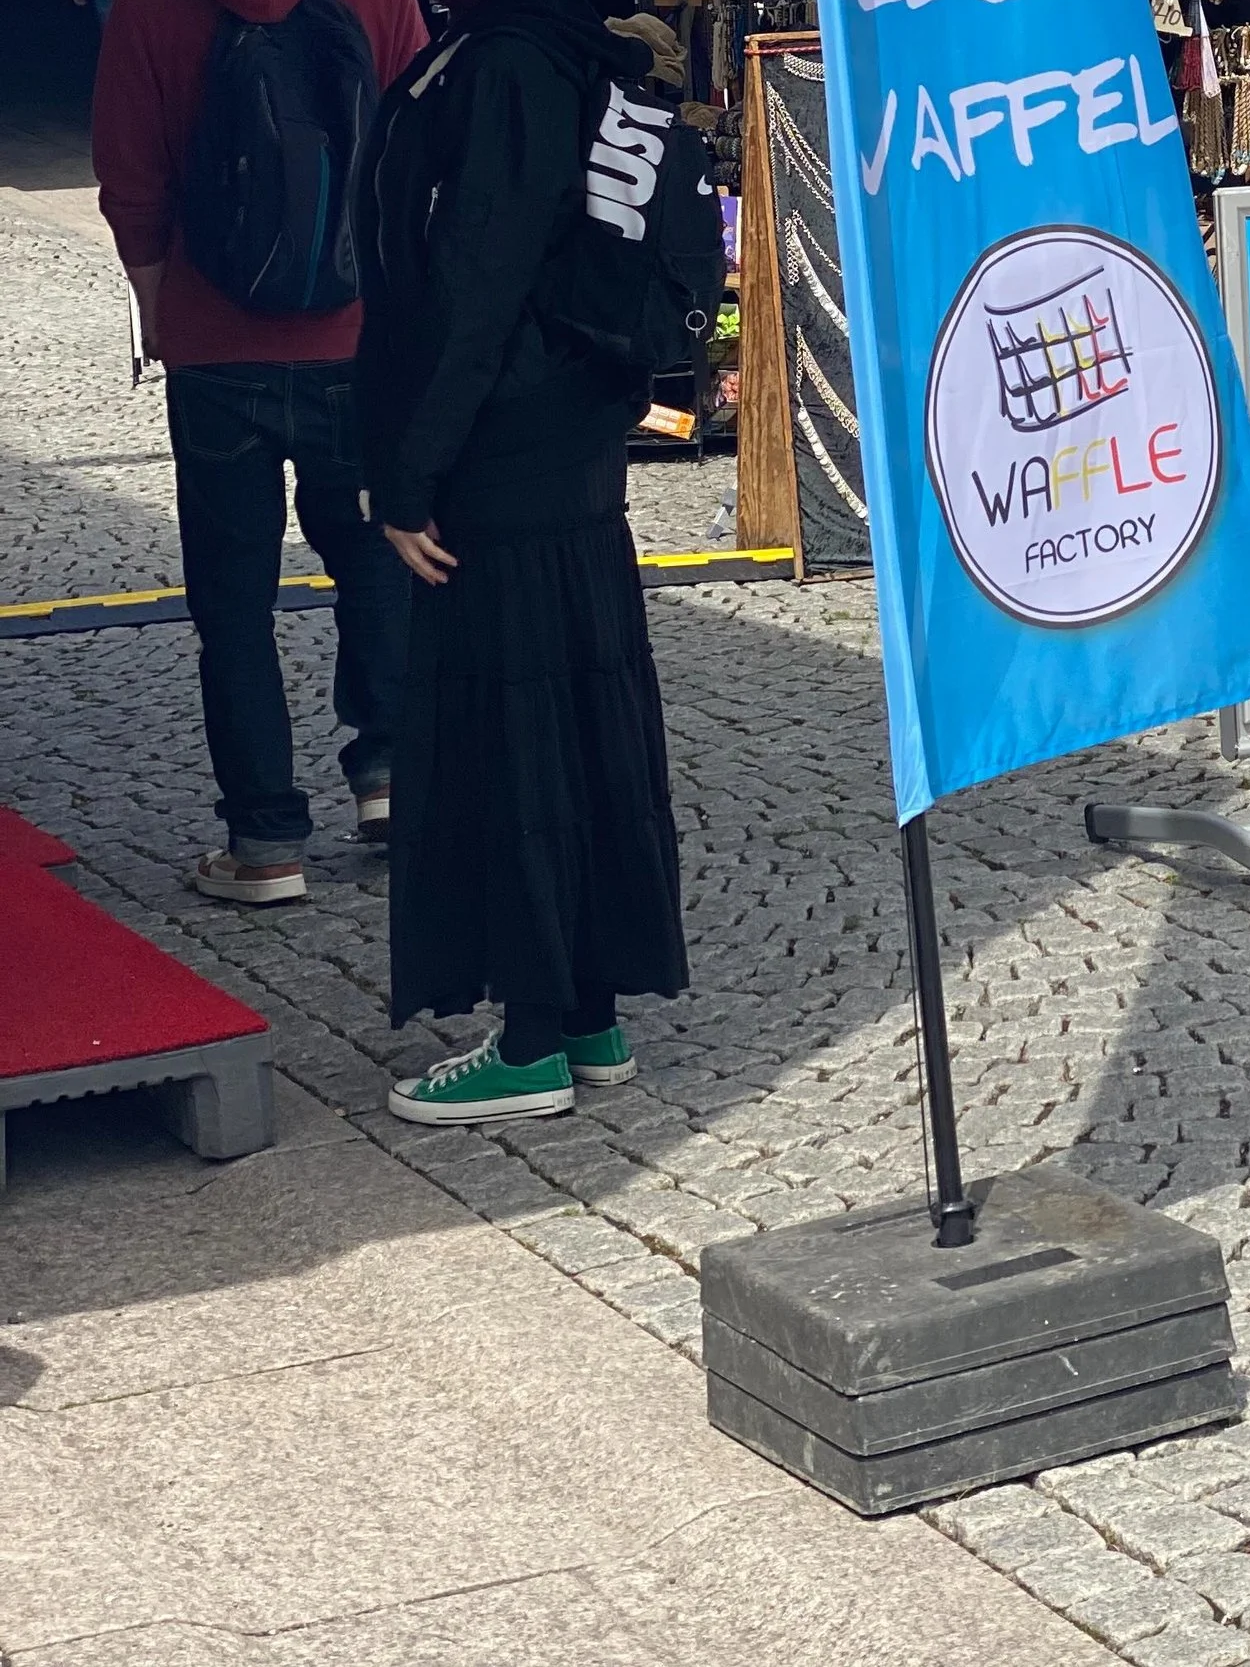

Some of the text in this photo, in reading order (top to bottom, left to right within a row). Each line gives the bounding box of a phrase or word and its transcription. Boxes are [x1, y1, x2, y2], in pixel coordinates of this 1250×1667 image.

[586, 81, 675, 242] JUST
[972, 423, 1187, 527] WAFFLE
[1025, 513, 1156, 574] FACTORY
